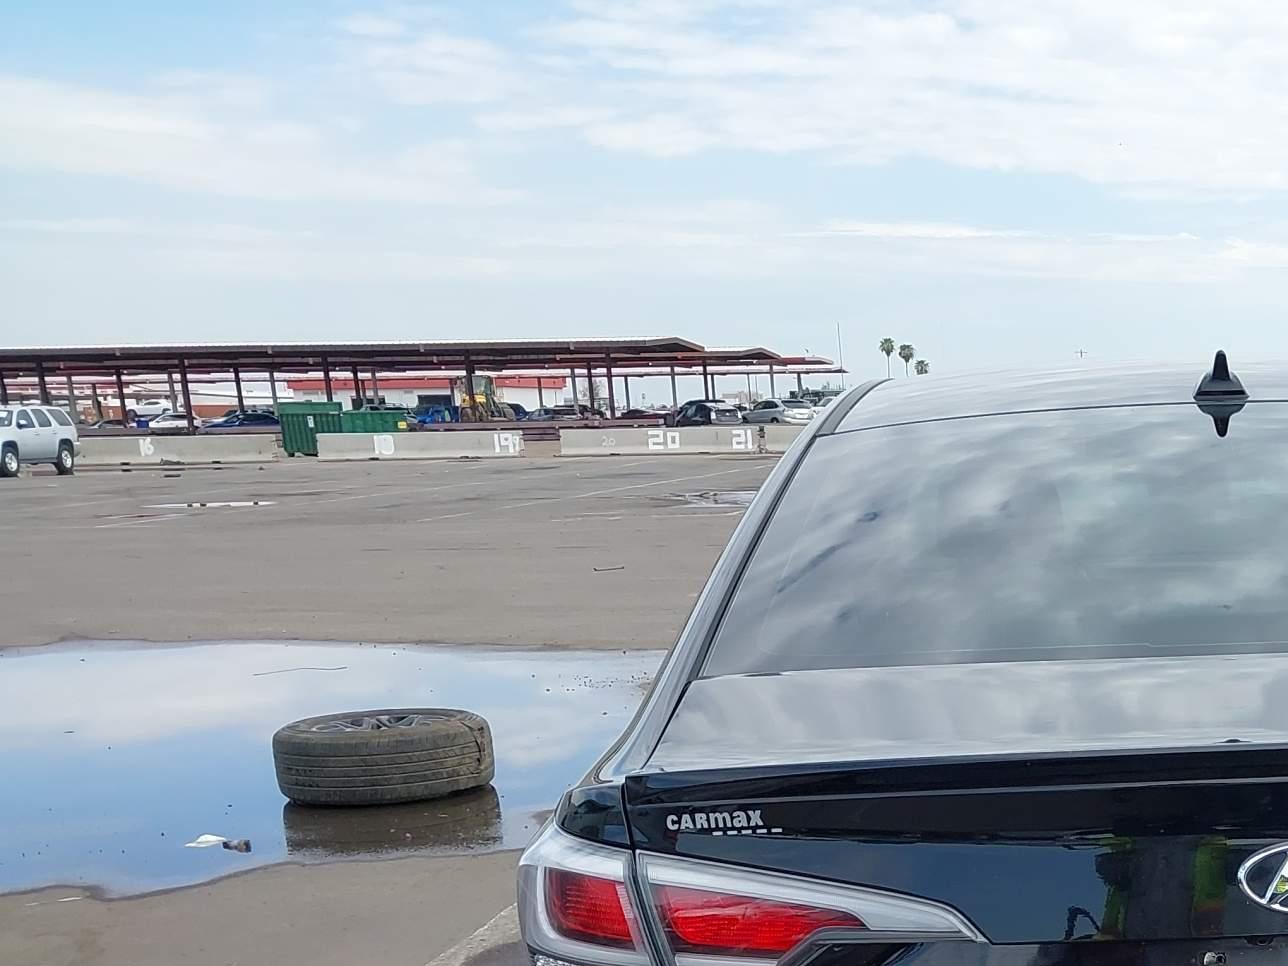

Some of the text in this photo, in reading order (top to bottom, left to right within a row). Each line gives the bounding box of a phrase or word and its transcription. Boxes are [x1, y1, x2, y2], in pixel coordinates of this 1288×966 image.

[138, 437, 155, 457] 16
[601, 436, 616, 447] 20
[647, 430, 681, 450] 20
[731, 429, 754, 449] 21
